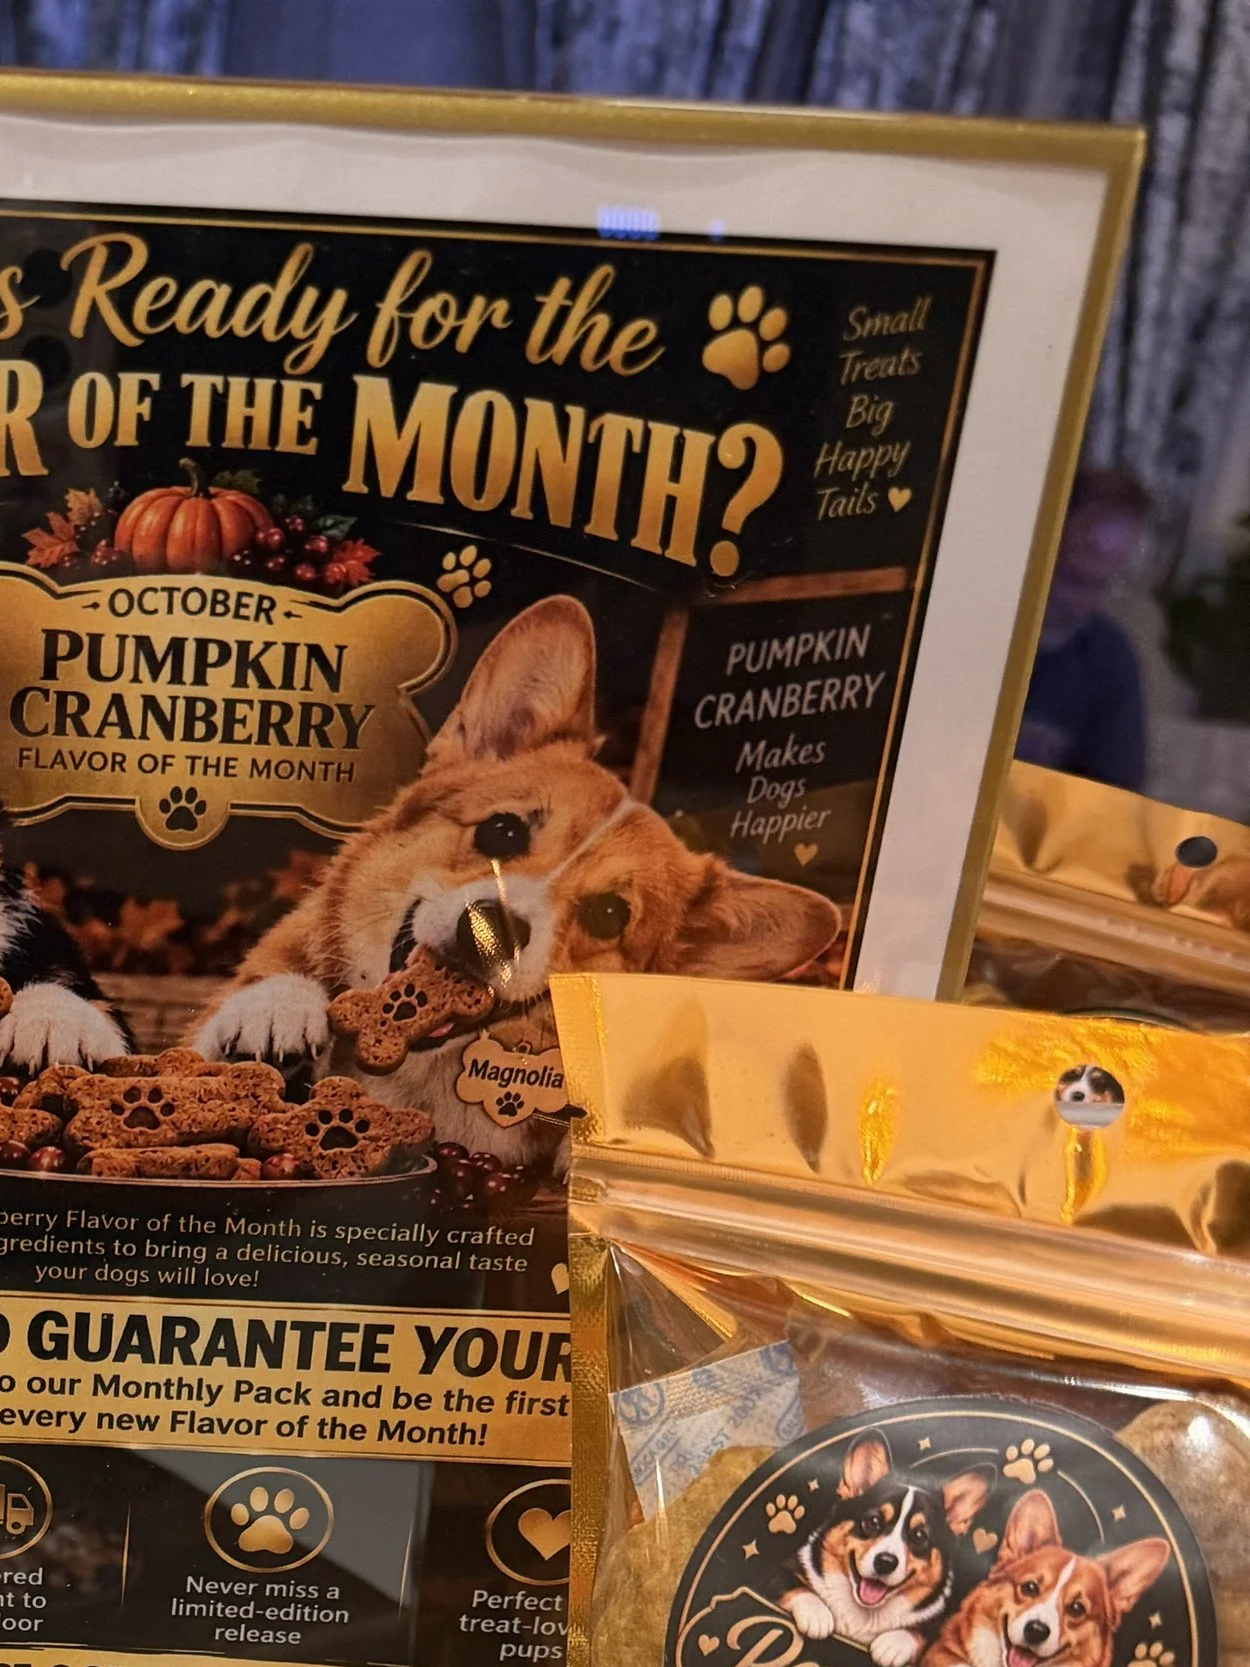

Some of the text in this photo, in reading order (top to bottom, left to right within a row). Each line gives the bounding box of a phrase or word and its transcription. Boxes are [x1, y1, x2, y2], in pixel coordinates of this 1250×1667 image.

[61, 233, 358, 375] Ready
[368, 249, 513, 371] for
[527, 264, 667, 377] the
[843, 297, 931, 341] Small
[840, 347, 923, 386] Treats
[846, 394, 894, 437] Big
[67, 371, 161, 450] OF
[181, 375, 323, 455] THE
[342, 373, 784, 579] MONTH?
[814, 440, 910, 481] Happy
[817, 481, 878, 520] Tails
[109, 587, 277, 625] OCTOBER
[41, 628, 347, 692] PUMPKIN
[726, 624, 871, 676] PUMPKIN
[9, 687, 376, 749] CRANBERRY
[694, 671, 885, 729] CRANBERRY
[18, 747, 355, 782] FLAVOR OF THE MONTH
[735, 733, 826, 773] Makes
[746, 776, 807, 809] Dogs
[730, 805, 831, 844] Happier
[468, 1058, 564, 1089] Magnolia
[66, 1210, 140, 1231] Flavor
[147, 1214, 172, 1232] of
[179, 1215, 216, 1235] the
[225, 1218, 301, 1238] Month
[310, 1222, 327, 1238] is
[335, 1223, 439, 1247] specially
[447, 1226, 535, 1246] crafted
[113, 1239, 135, 1256] to
[145, 1242, 206, 1263] bring
[215, 1247, 228, 1261] a
[237, 1244, 349, 1268] delicious,
[357, 1250, 461, 1270] seasonal
[469, 1253, 528, 1272] taste
[35, 1263, 260, 1287] your dogs will love!
[27, 1310, 396, 1373] GUARANTEE
[414, 1325, 571, 1383] YOUR
[26, 1374, 81, 1396] our
[92, 1374, 224, 1406] Monthly
[234, 1379, 311, 1407] Pack
[322, 1384, 381, 1409] and
[392, 1387, 432, 1411] be
[443, 1389, 495, 1414] the
[505, 1390, 570, 1417] first
[96, 1411, 160, 1432] new
[169, 1409, 268, 1438] Flavor
[275, 1413, 309, 1440] of
[317, 1416, 367, 1442] the
[377, 1418, 488, 1446] Month!
[23, 1592, 47, 1610] to
[185, 1575, 340, 1600] Never miss a
[472, 1589, 563, 1611] Perfect
[171, 1599, 349, 1624] limited-edition
[459, 1614, 569, 1636] treat-lov
[214, 1624, 302, 1645] release
[499, 1643, 563, 1663] pups
